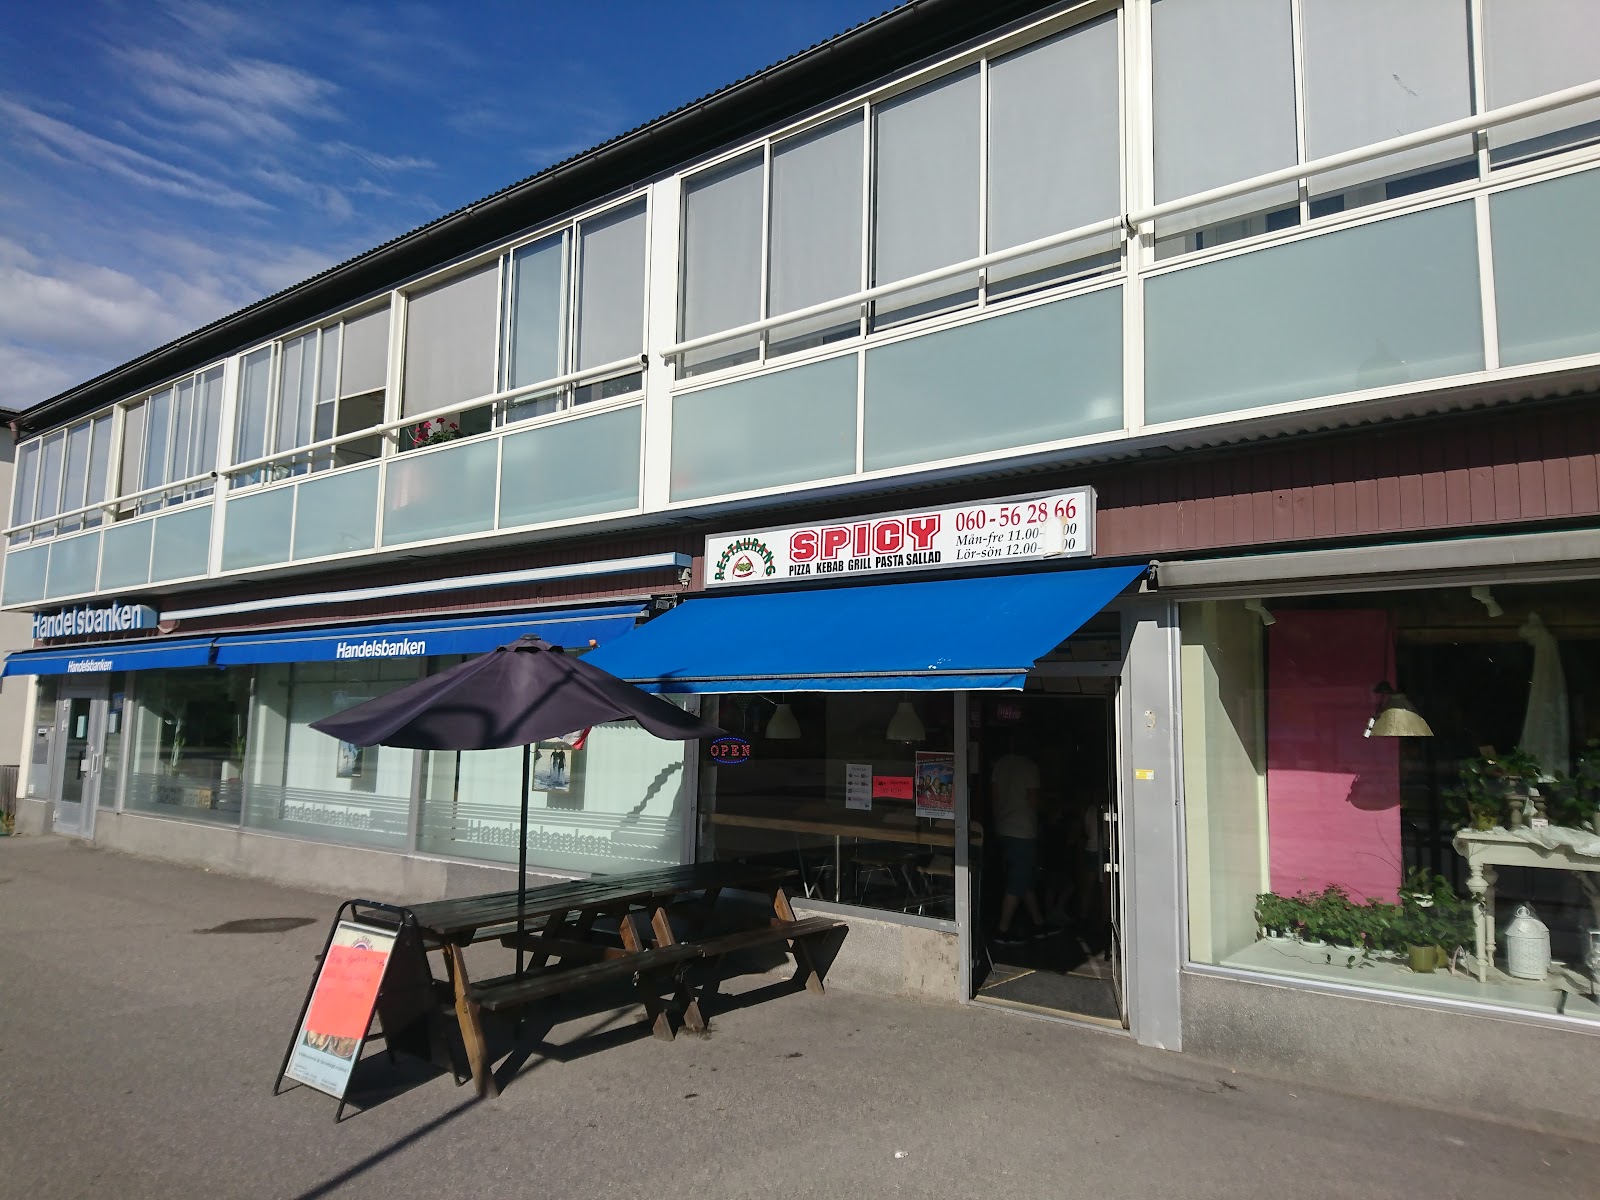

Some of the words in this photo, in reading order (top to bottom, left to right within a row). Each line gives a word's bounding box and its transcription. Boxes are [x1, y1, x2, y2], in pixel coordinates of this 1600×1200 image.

[1027, 502, 1048, 524] 28
[1054, 497, 1077, 519] 66
[789, 514, 941, 563] SPICY
[955, 531, 1004, 548] Mån-fre
[714, 537, 776, 581] RESTAURANG
[788, 563, 811, 577] PIZZA
[816, 560, 844, 574] KEBAB
[848, 557, 872, 571] GRILL
[875, 554, 904, 568] PASTA
[906, 551, 941, 566] SALLAD
[956, 546, 1002, 561] Lör-sön
[32, 602, 142, 639] Handelsbanken
[336, 638, 426, 659] Handelsbanken
[67, 659, 113, 673] Handelsbanken
[710, 744, 751, 757] OPEN
[470, 818, 612, 854] Handesbanken
